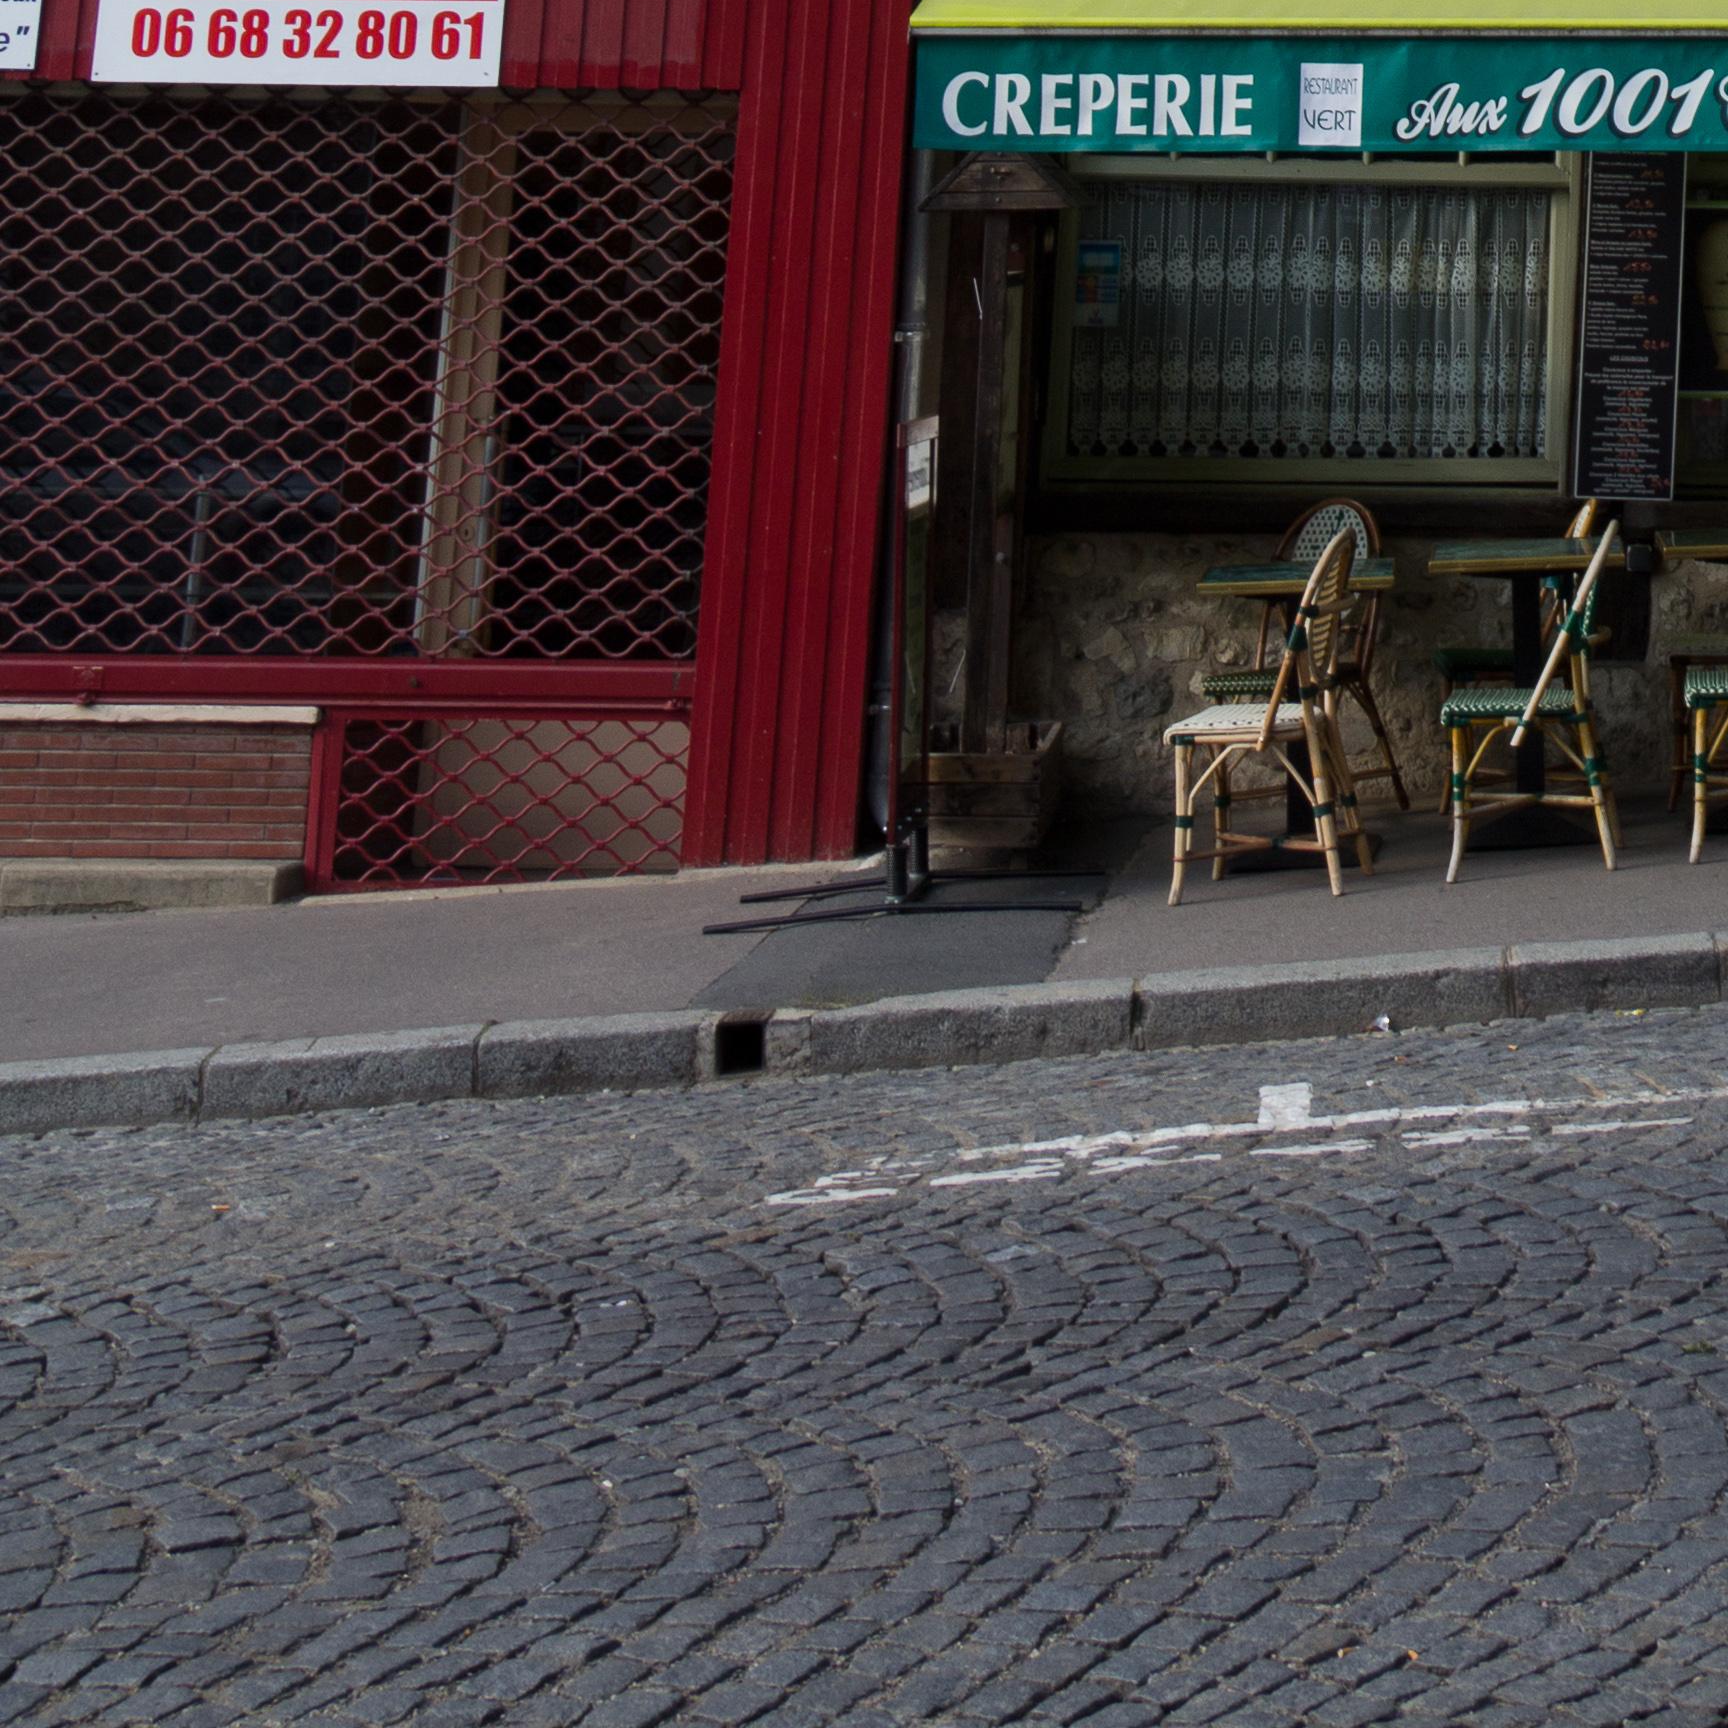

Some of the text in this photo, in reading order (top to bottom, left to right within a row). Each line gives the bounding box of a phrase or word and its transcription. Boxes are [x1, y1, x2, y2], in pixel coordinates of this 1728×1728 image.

[131, 8, 485, 60] 06 68 32 80 61
[942, 71, 1254, 137] CREPERIE
[1303, 77, 1358, 95] RESTAURANT
[1397, 82, 1507, 140] Aux
[1521, 67, 1714, 134] 1001
[1303, 109, 1356, 131] VERT
